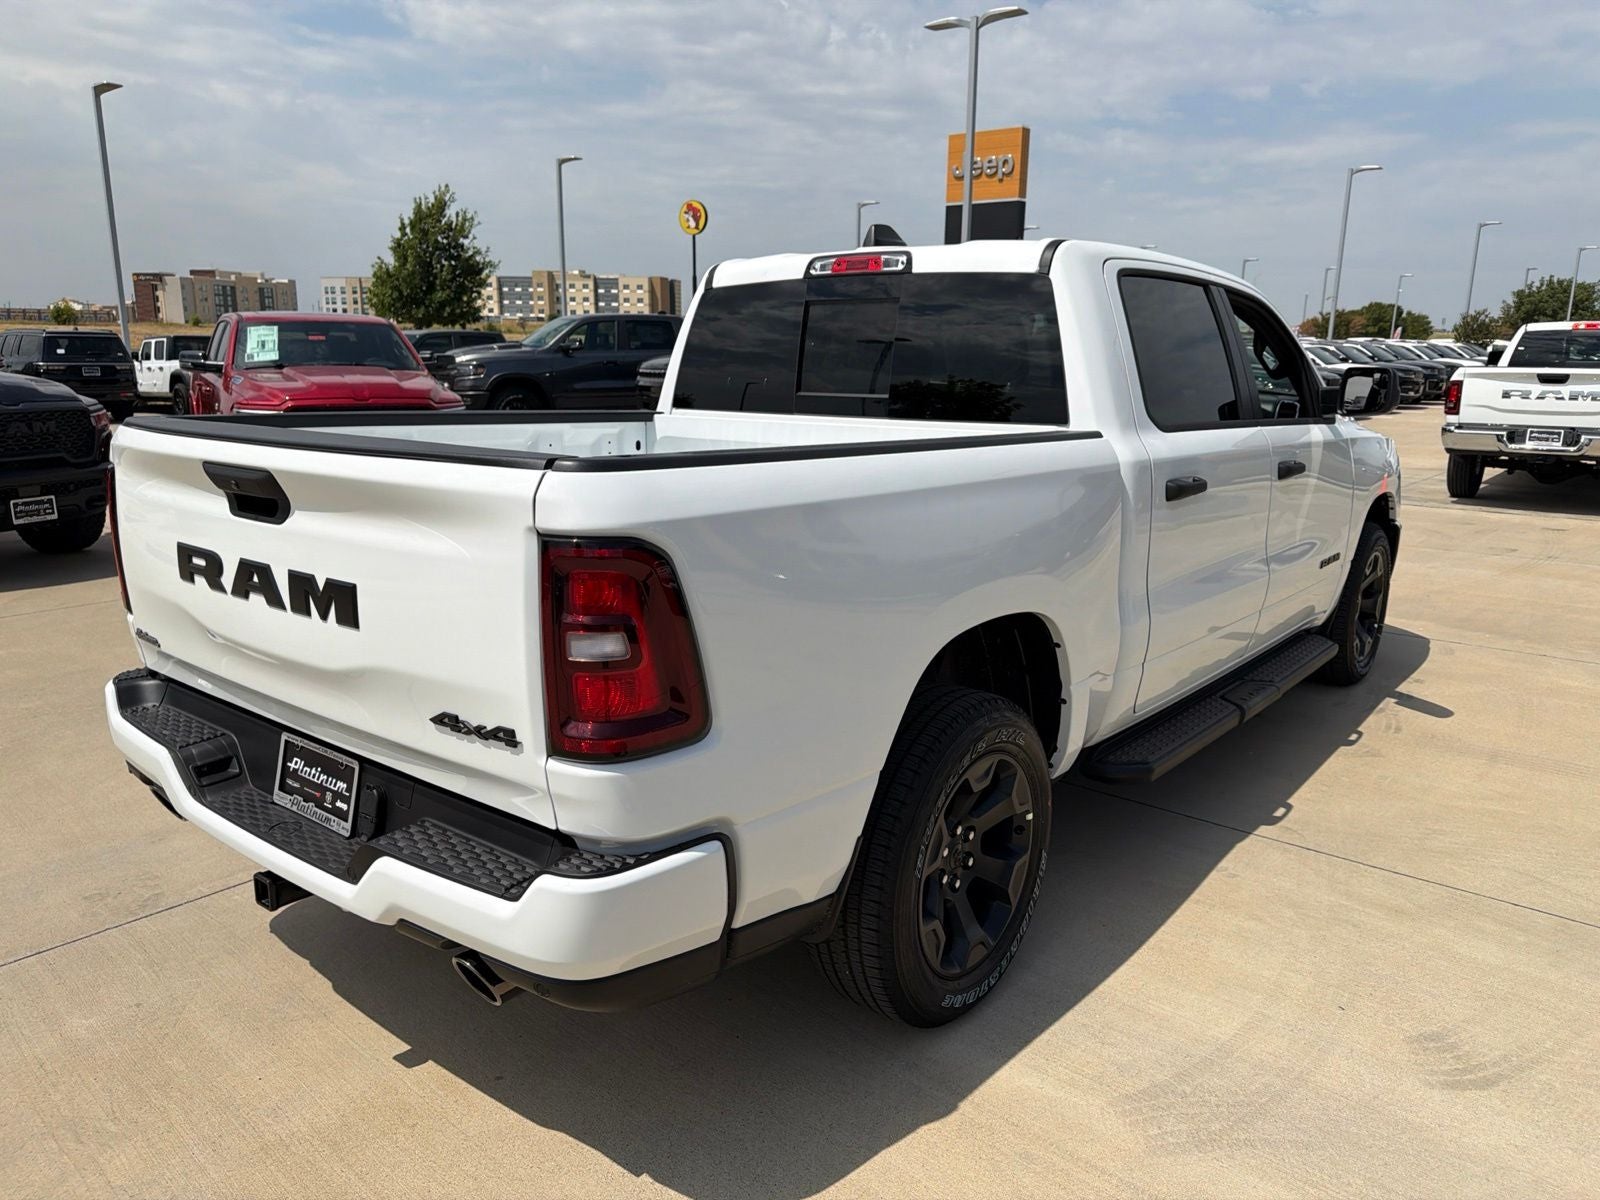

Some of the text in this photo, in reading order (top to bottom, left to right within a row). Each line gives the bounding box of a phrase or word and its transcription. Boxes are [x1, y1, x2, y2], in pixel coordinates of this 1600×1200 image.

[1501, 389, 1600, 401] RAM
[177, 541, 360, 632] RAM
[286, 756, 350, 796] Platinum
[290, 796, 335, 828] Platinum
[941, 848, 1049, 1008] BRIDGESTONE
